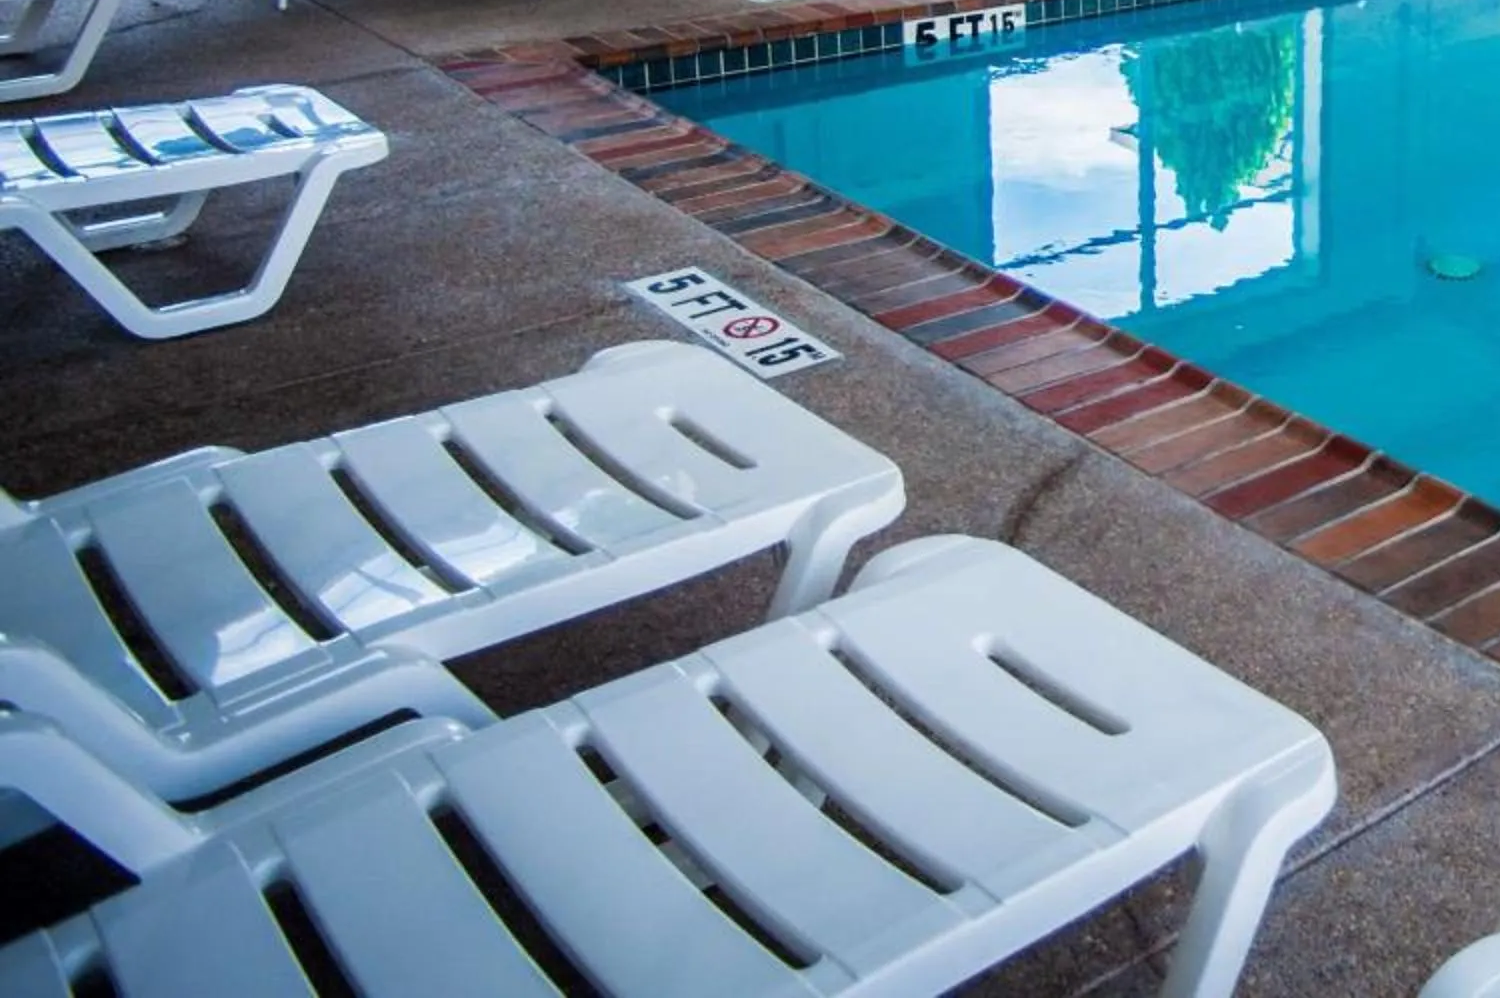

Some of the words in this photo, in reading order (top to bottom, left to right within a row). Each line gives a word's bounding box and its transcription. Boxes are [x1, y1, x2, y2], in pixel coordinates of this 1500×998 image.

[915, 20, 938, 46] 5
[949, 13, 984, 40] FT
[648, 273, 705, 294] 5
[671, 290, 747, 320] FT
